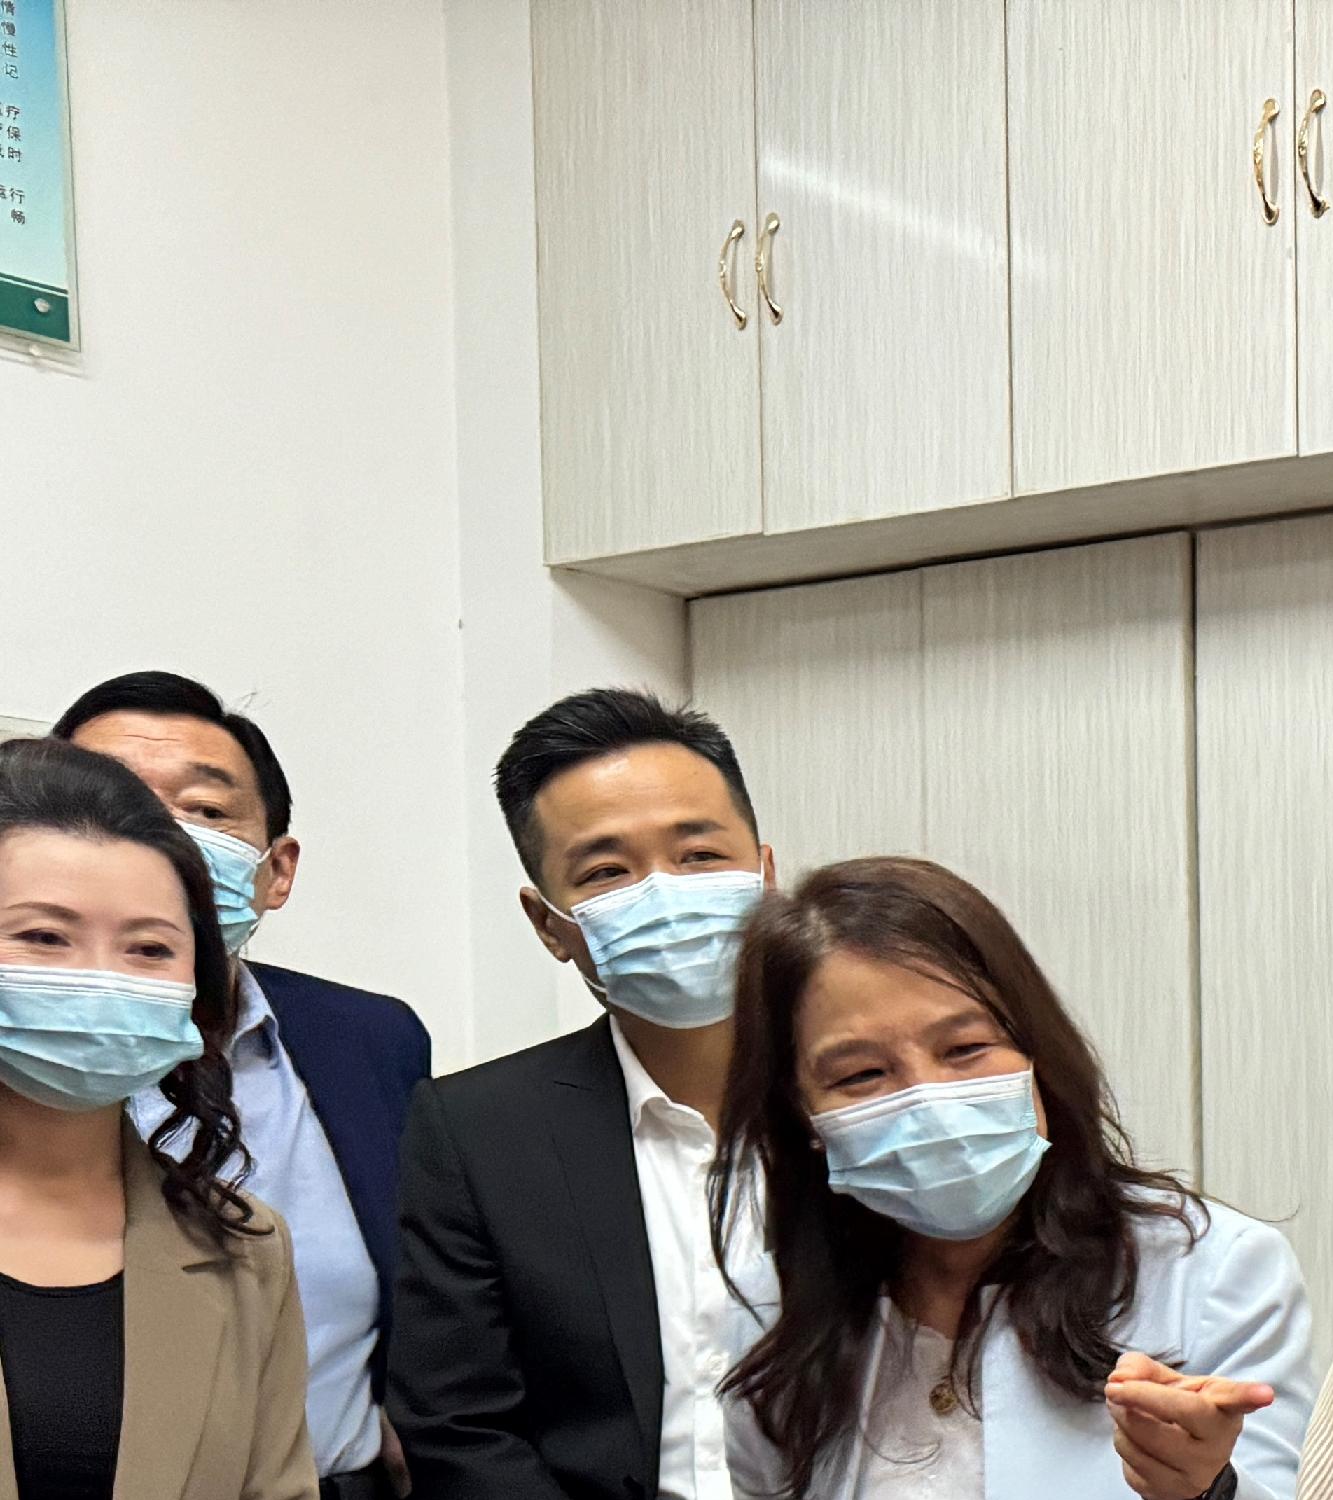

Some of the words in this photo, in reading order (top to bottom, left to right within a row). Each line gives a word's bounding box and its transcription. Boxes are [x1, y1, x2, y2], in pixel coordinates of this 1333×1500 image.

[0, 102, 21, 120] 疗
[0, 123, 21, 141] 保
[0, 144, 22, 162] 时
